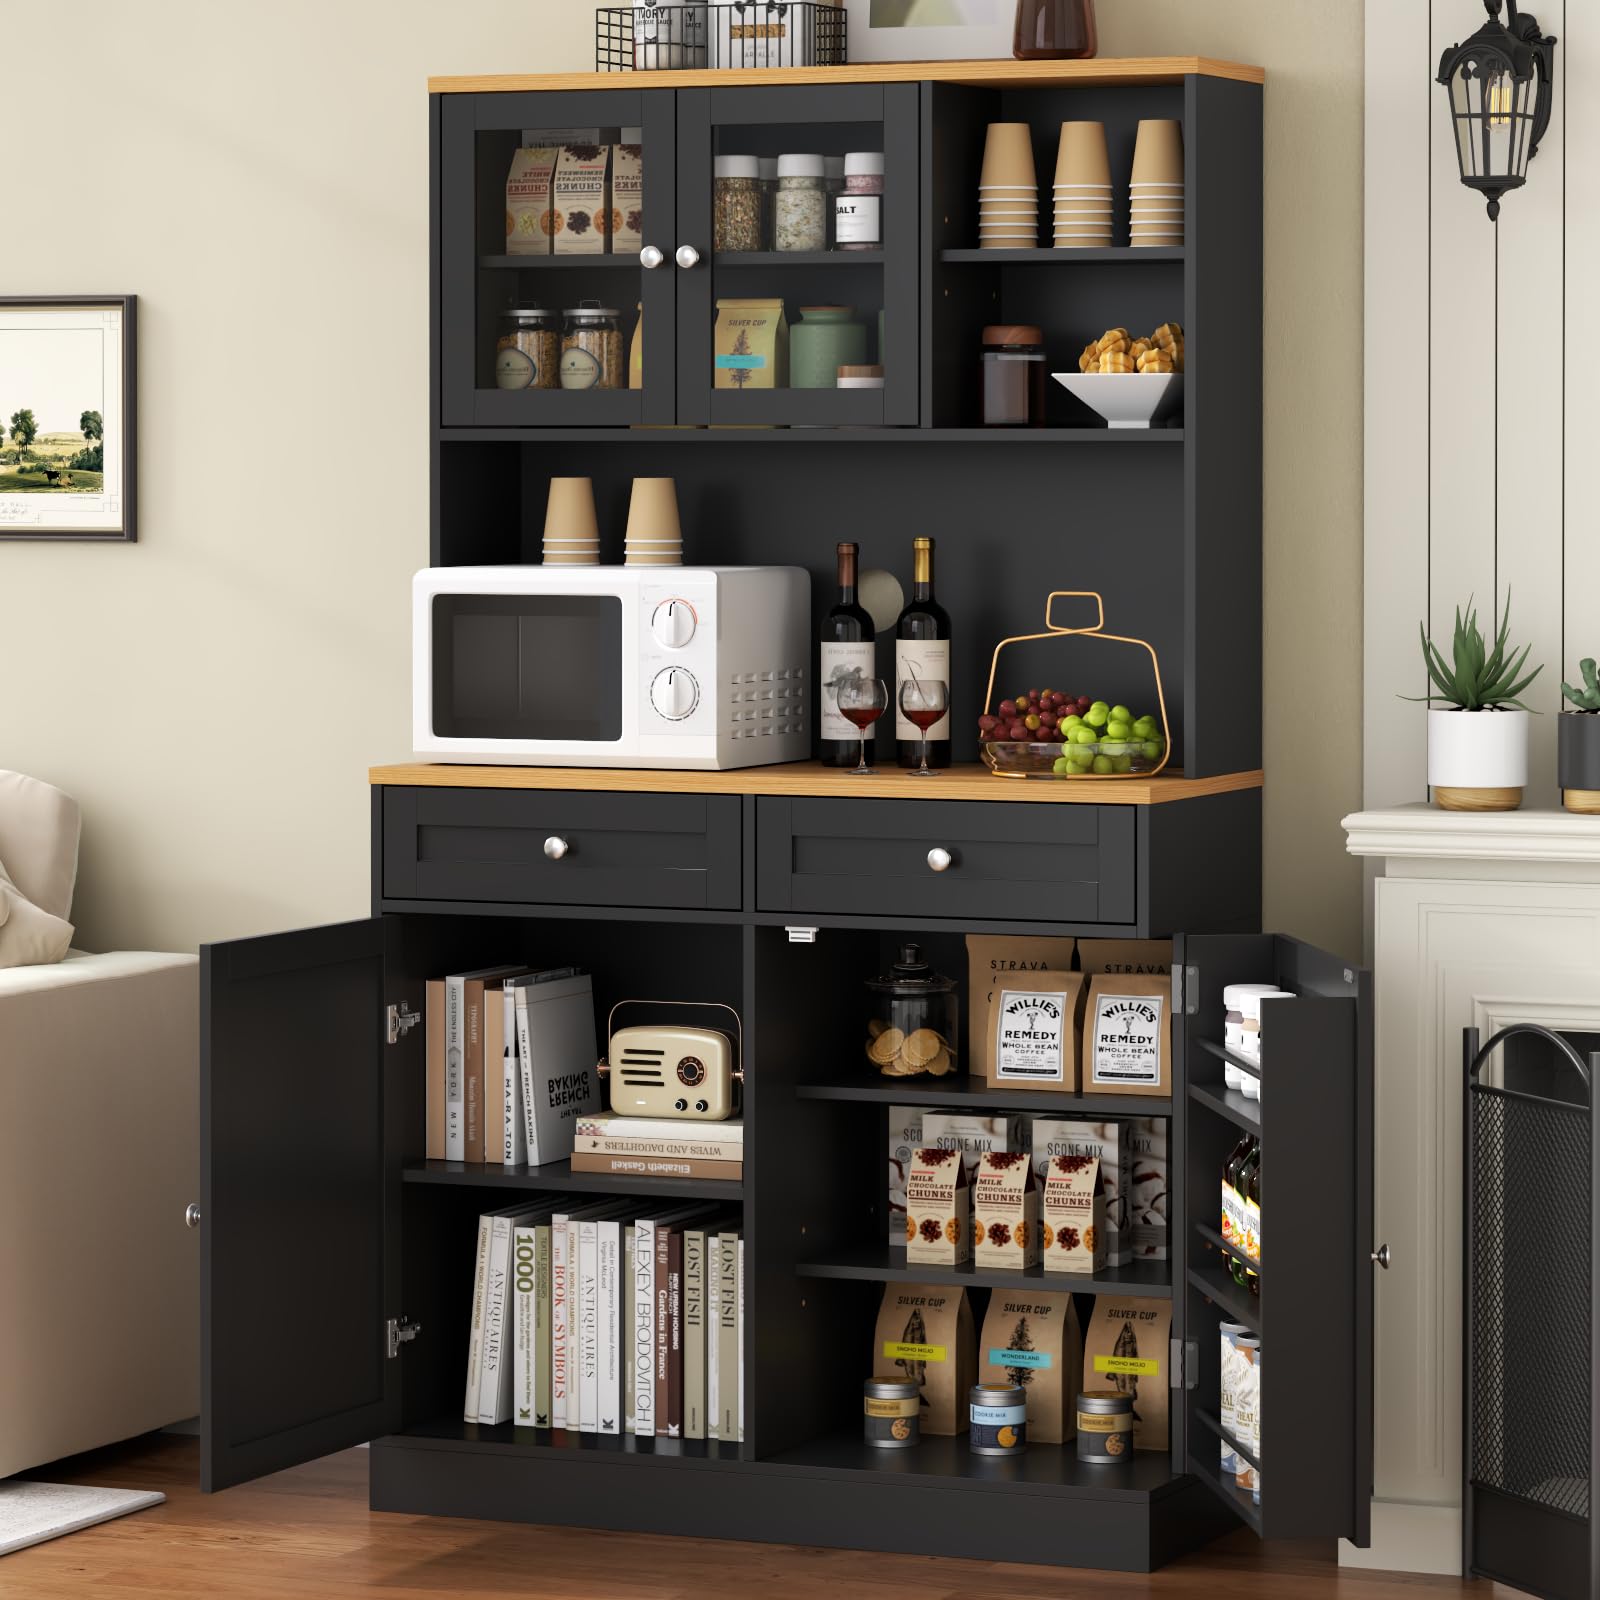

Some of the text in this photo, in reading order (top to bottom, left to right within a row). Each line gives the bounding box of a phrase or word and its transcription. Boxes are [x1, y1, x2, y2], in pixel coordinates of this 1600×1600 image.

[638, 8, 666, 19] IVORY
[728, 319, 767, 327] SILVER CUP
[991, 960, 1048, 970] STRAVA
[1105, 964, 1165, 974] STRAVA
[1006, 998, 1060, 1019] WILLIE'S
[1102, 1002, 1156, 1023] WILLIE'S
[1005, 1030, 1056, 1040] REMEDY
[1101, 1034, 1153, 1044] REMEDY
[604, 1141, 721, 1156] WIVES AND DAUGHTERS
[937, 1137, 992, 1152] SCONE MIX
[1047, 1142, 1104, 1158] SCONE MIX
[611, 1159, 690, 1174] Elizabeth Gaskell
[909, 1190, 953, 1199] CHUNKS
[977, 1193, 1021, 1202] CHUNKS
[1046, 1197, 1090, 1206] CHUNKS
[516, 1234, 534, 1293] 1000
[555, 1265, 566, 1305] BOOK
[687, 1237, 700, 1326] LOST FISH
[722, 1239, 735, 1328] LOST FISH
[898, 1296, 946, 1307] SILVER CUP
[1003, 1304, 1052, 1315] SILVER CUP
[1108, 1309, 1158, 1320] SILVER CUP
[488, 1268, 504, 1371] ANTIQUAIRES
[584, 1275, 595, 1378] ANTIQUAIRES
[637, 1226, 651, 1421] ALEXEY BRODOVITCH
[658, 1289, 667, 1380] Gardens in France
[555, 1324, 566, 1399] SYMBOLS
[1001, 1353, 1040, 1361] WONDERLAND
